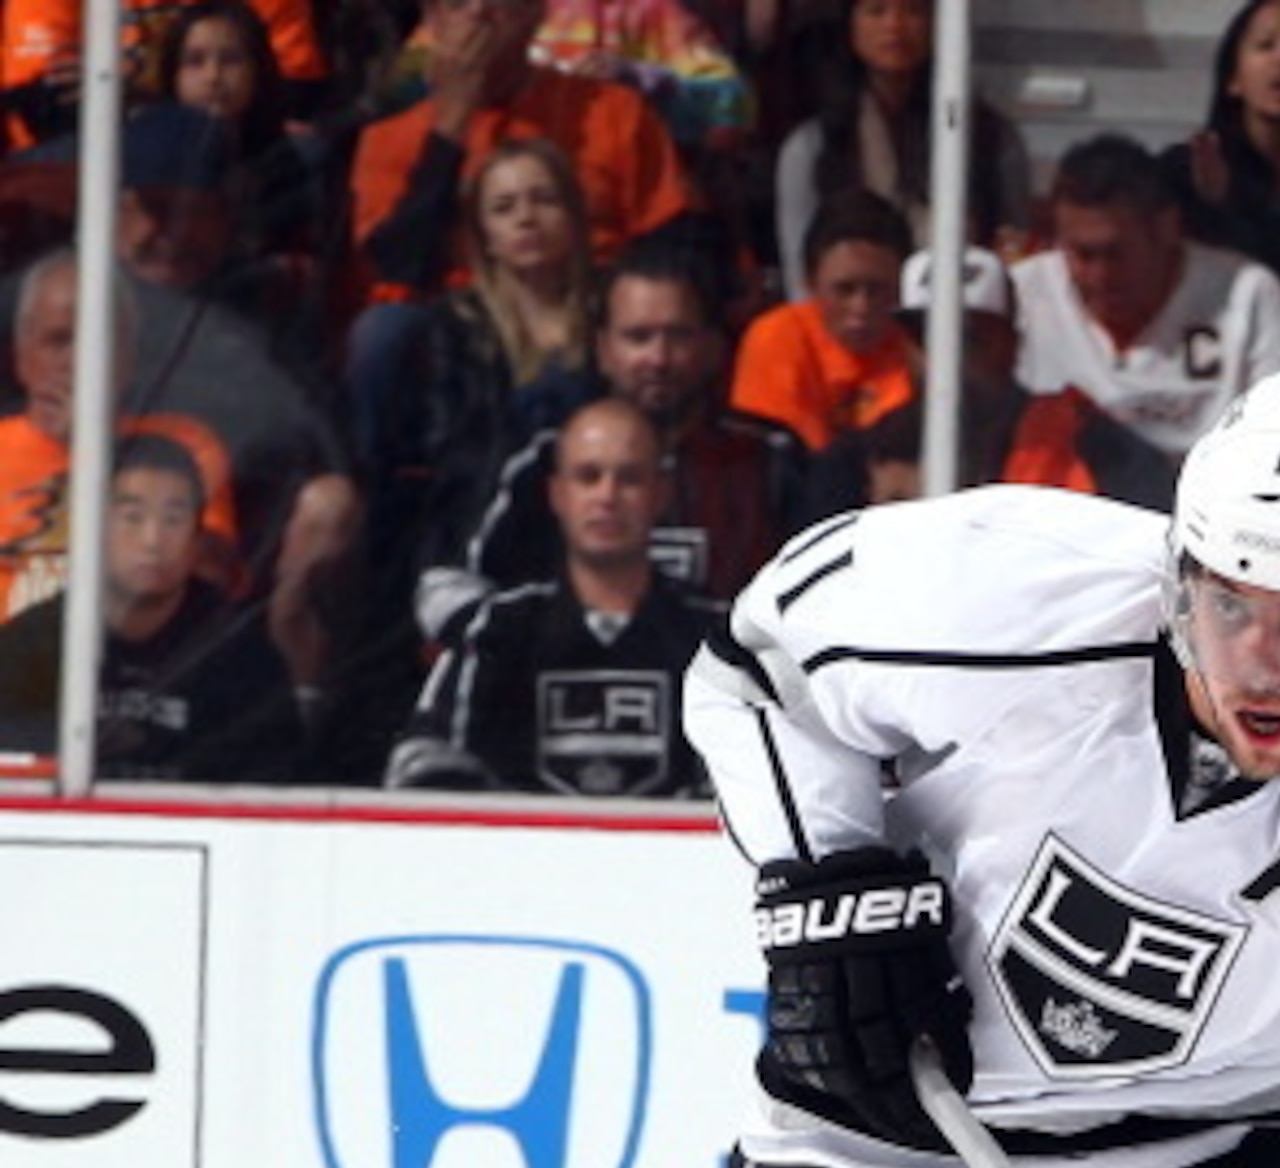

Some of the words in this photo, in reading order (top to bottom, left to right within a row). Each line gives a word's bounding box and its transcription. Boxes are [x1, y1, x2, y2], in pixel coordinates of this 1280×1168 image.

[1185, 325, 1222, 382] C
[551, 685, 656, 730] LA
[754, 881, 943, 950] BAUER
[1026, 866, 1222, 1001] LA
